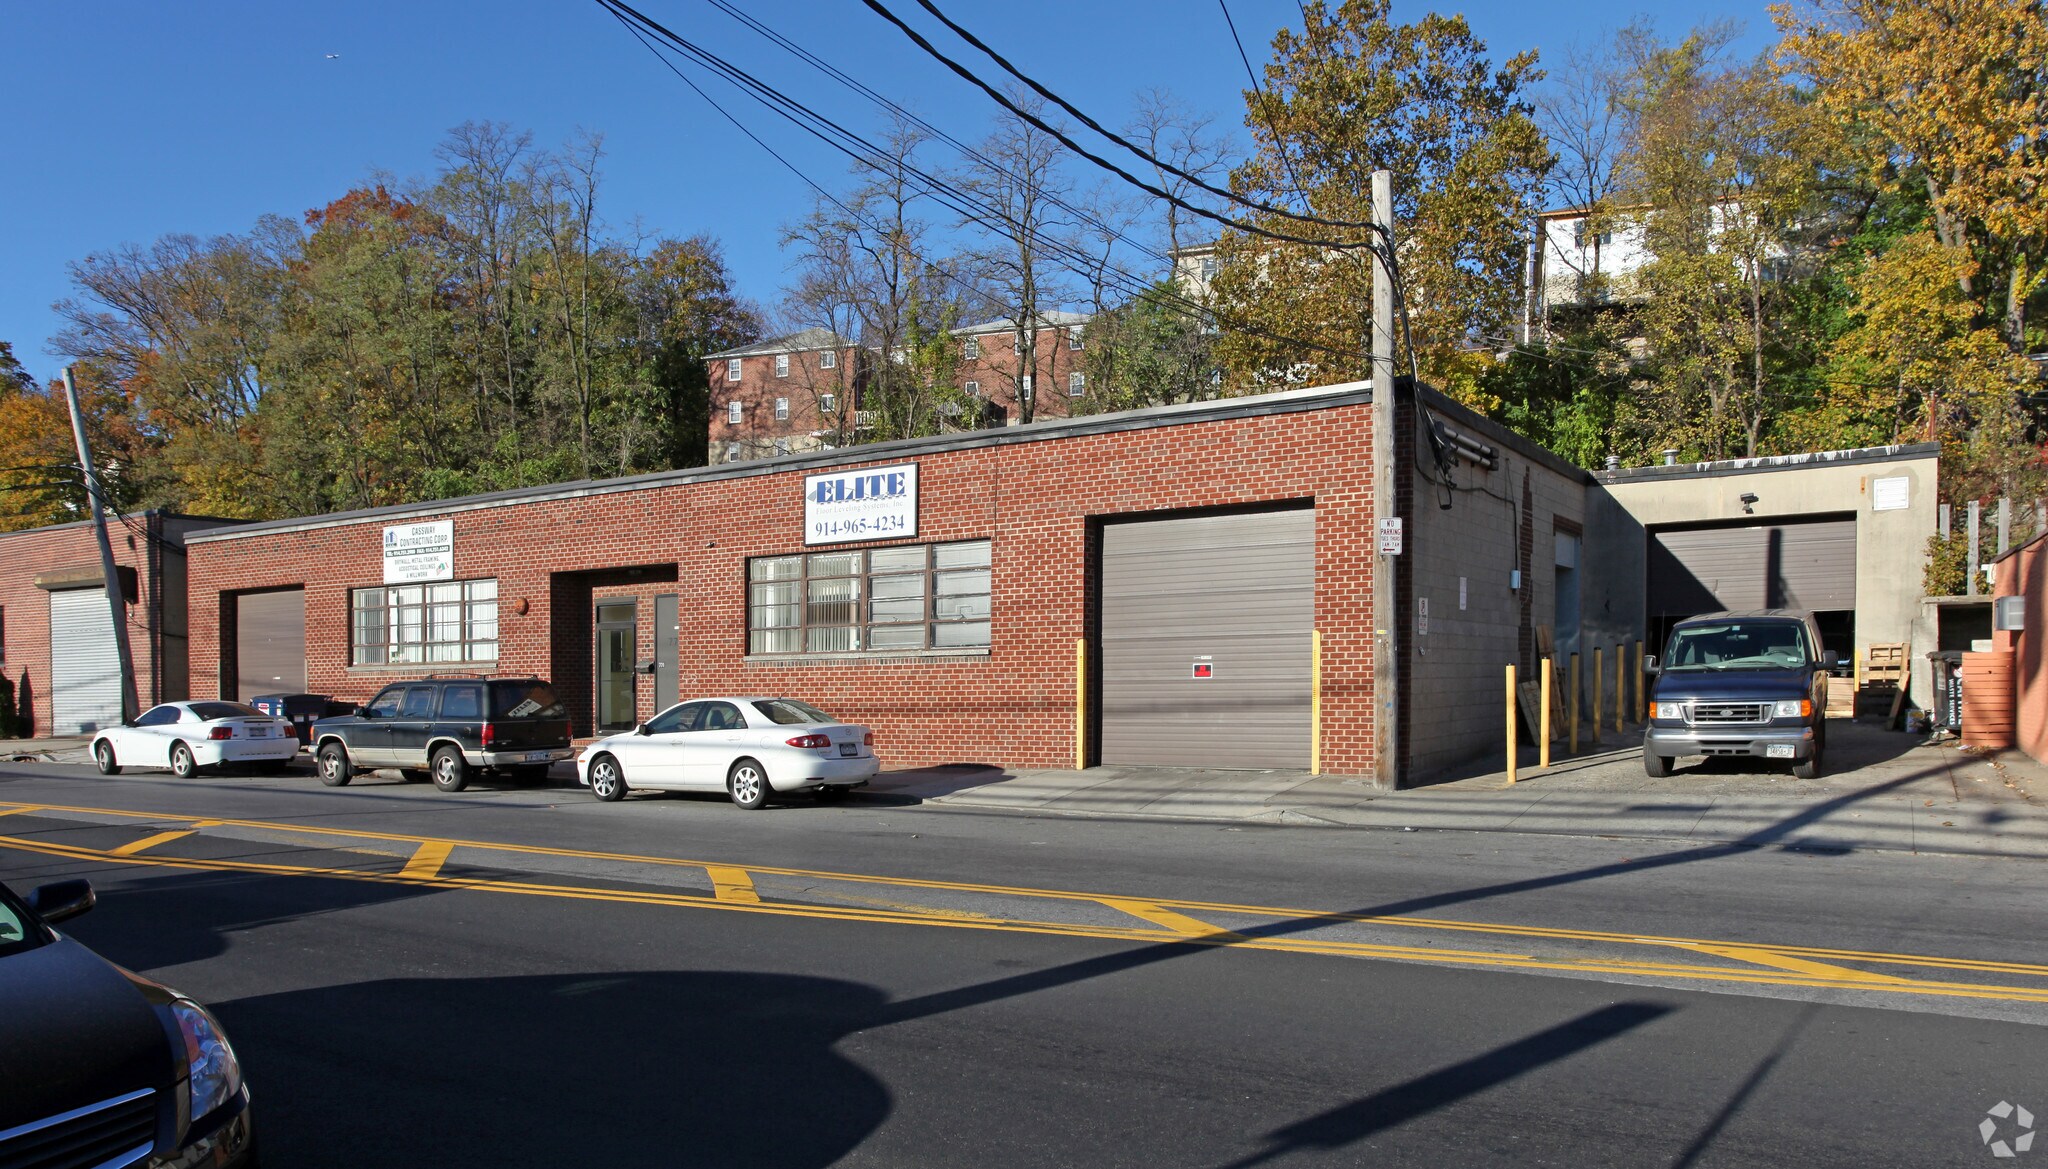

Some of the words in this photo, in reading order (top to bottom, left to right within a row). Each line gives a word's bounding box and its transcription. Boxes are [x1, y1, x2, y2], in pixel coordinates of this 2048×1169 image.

[817, 472, 905, 503] ELITE
[411, 526, 435, 536] CASSWAY
[815, 515, 905, 537] 914-965-4234
[400, 536, 433, 547] CONTRACTING
